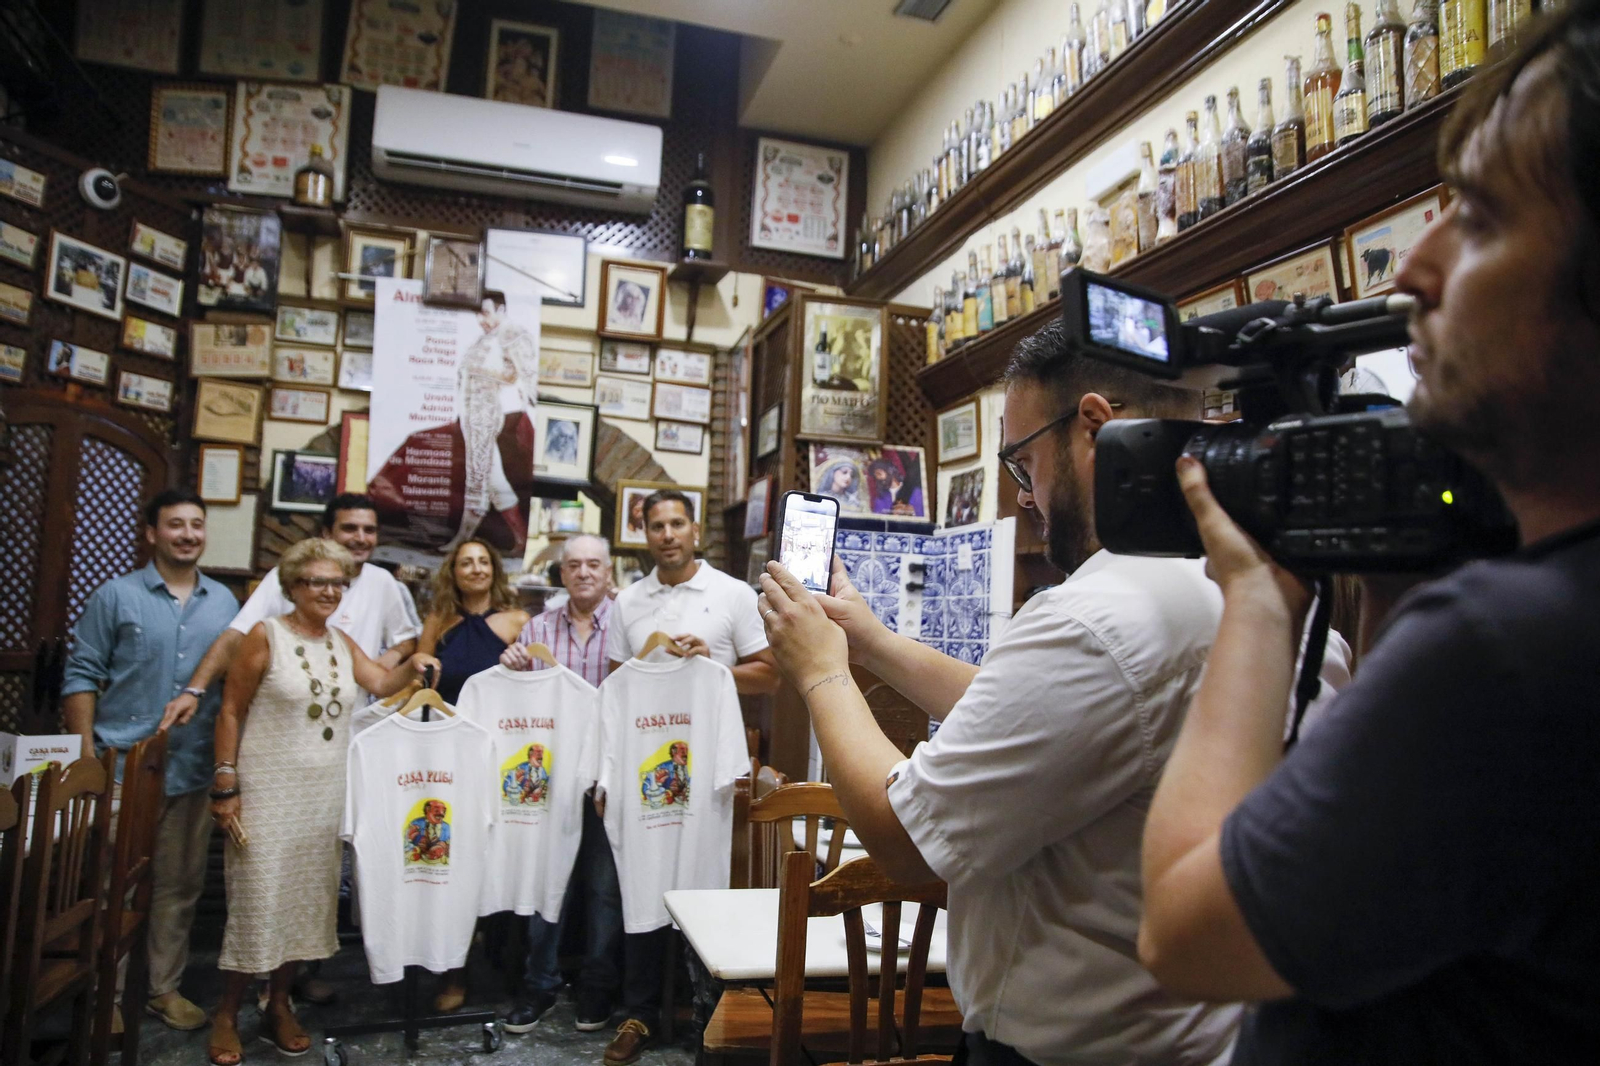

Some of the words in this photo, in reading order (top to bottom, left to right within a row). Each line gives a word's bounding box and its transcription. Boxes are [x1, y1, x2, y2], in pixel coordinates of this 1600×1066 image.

[406, 447, 452, 458] Hermoso
[405, 456, 452, 466] Mendoza
[407, 474, 451, 486] Morante
[401, 485, 450, 497] Talavante
[498, 717, 529, 731] CASA
[635, 713, 667, 729] CASA
[397, 770, 424, 786] CASA
